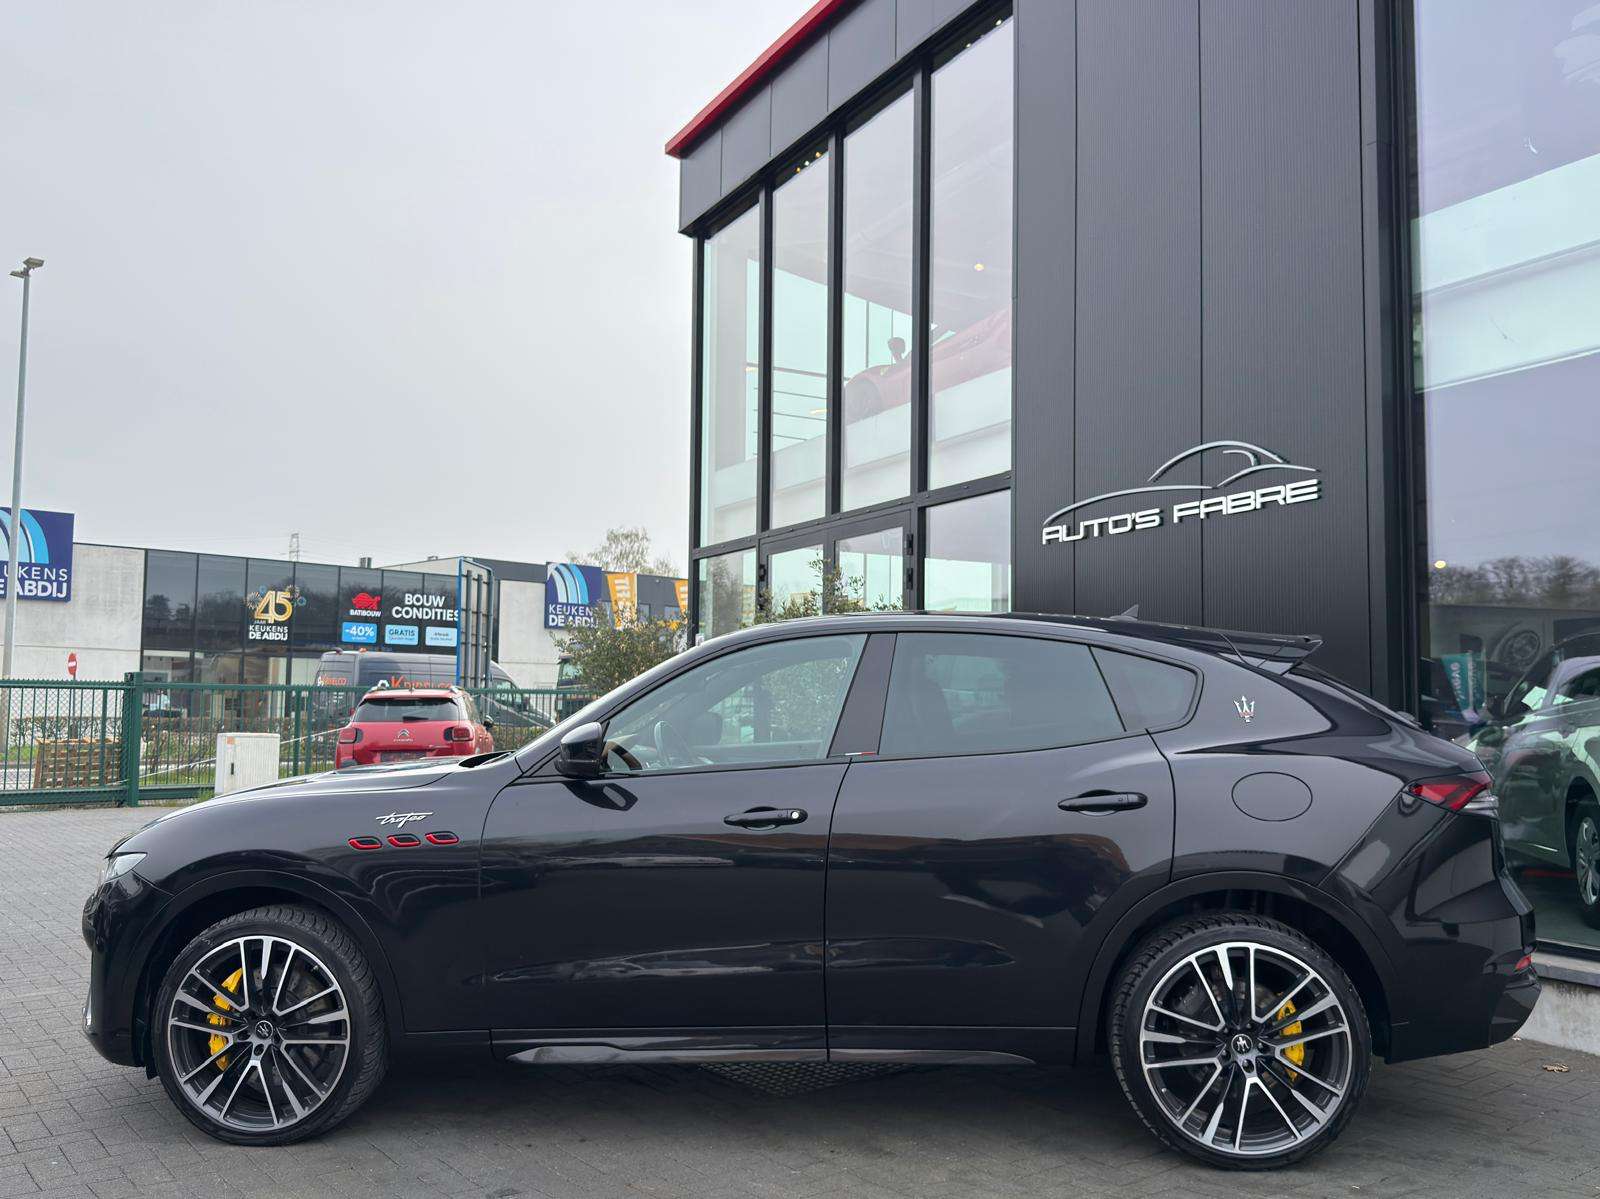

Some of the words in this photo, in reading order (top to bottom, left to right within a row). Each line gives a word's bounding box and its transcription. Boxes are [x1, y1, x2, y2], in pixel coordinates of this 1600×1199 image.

[1042, 508, 1161, 545] AUTO'S
[1172, 478, 1318, 524] FABRE
[254, 590, 293, 623] 45
[404, 593, 445, 608] BOUW
[349, 609, 382, 618] BATIBOUW
[548, 603, 594, 617] KEUKEN
[548, 614, 565, 627] DE
[249, 624, 289, 633] KEUKENS
[344, 625, 375, 638] -40%
[388, 628, 416, 637] GRATIS
[249, 631, 262, 640] DE
